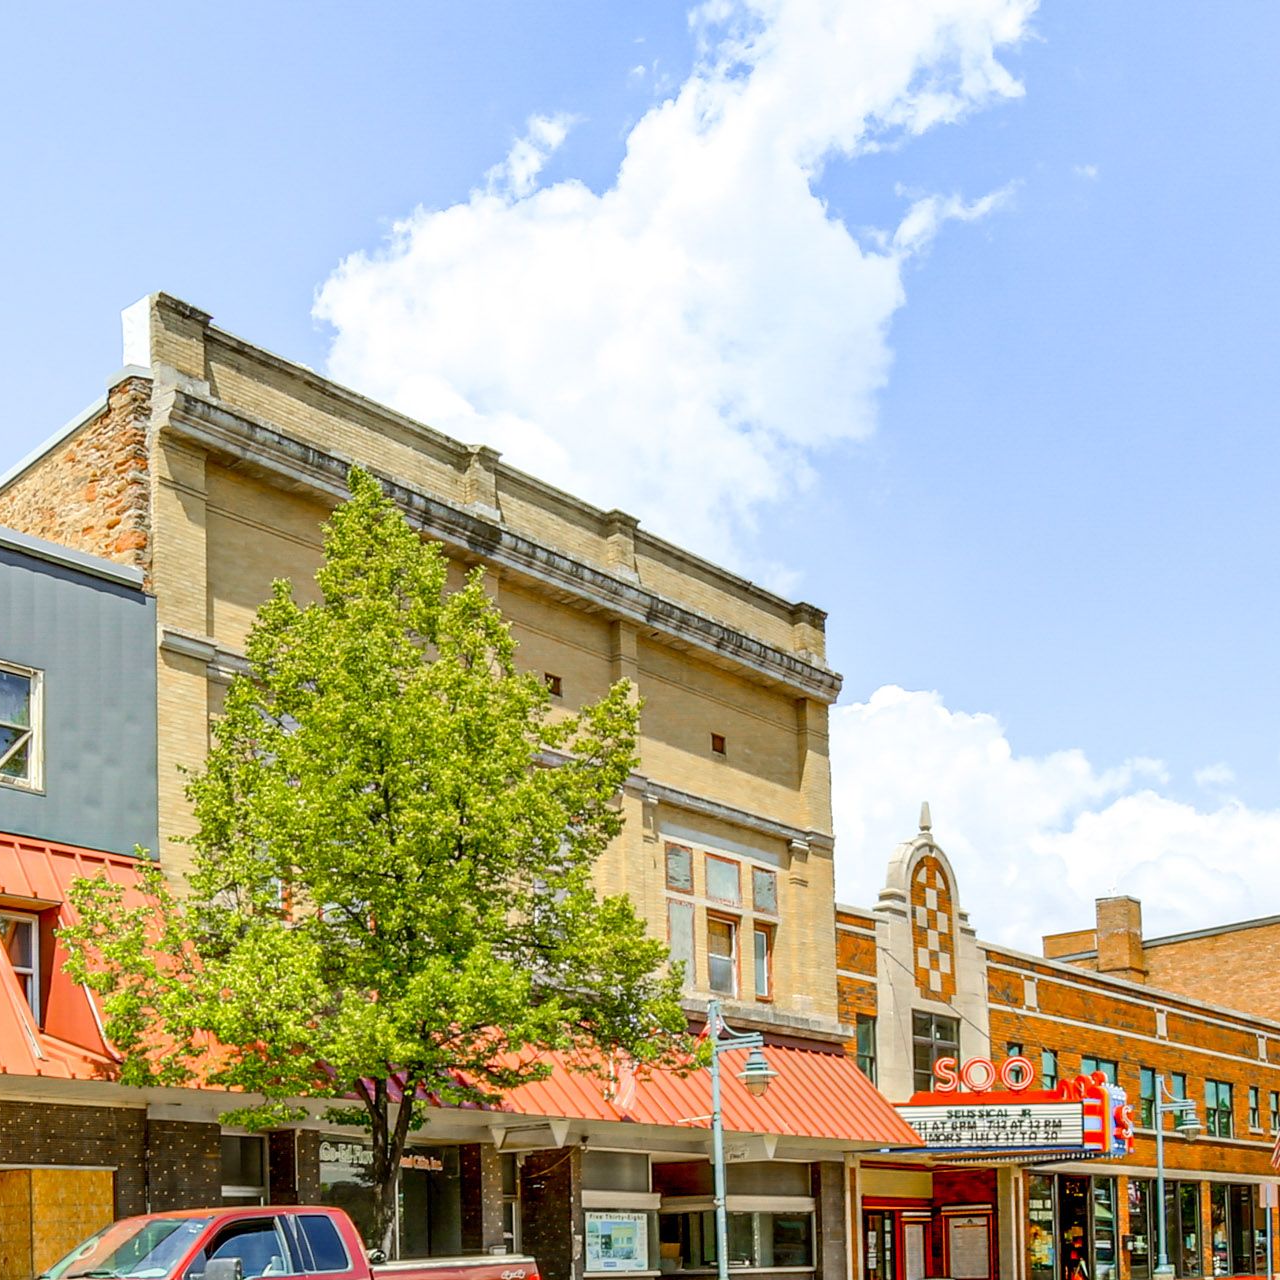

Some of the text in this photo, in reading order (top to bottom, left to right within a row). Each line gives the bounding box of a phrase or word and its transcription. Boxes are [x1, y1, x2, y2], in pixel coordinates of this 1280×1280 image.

[933, 1056, 1035, 1093] SOO
[932, 1121, 947, 1131] AT
[1011, 1120, 1024, 1130] AT
[1029, 1119, 1041, 1129] 12
[969, 1131, 1000, 1142] JULY
[1020, 1131, 1038, 1140] TO
[1044, 1130, 1058, 1140] 20
